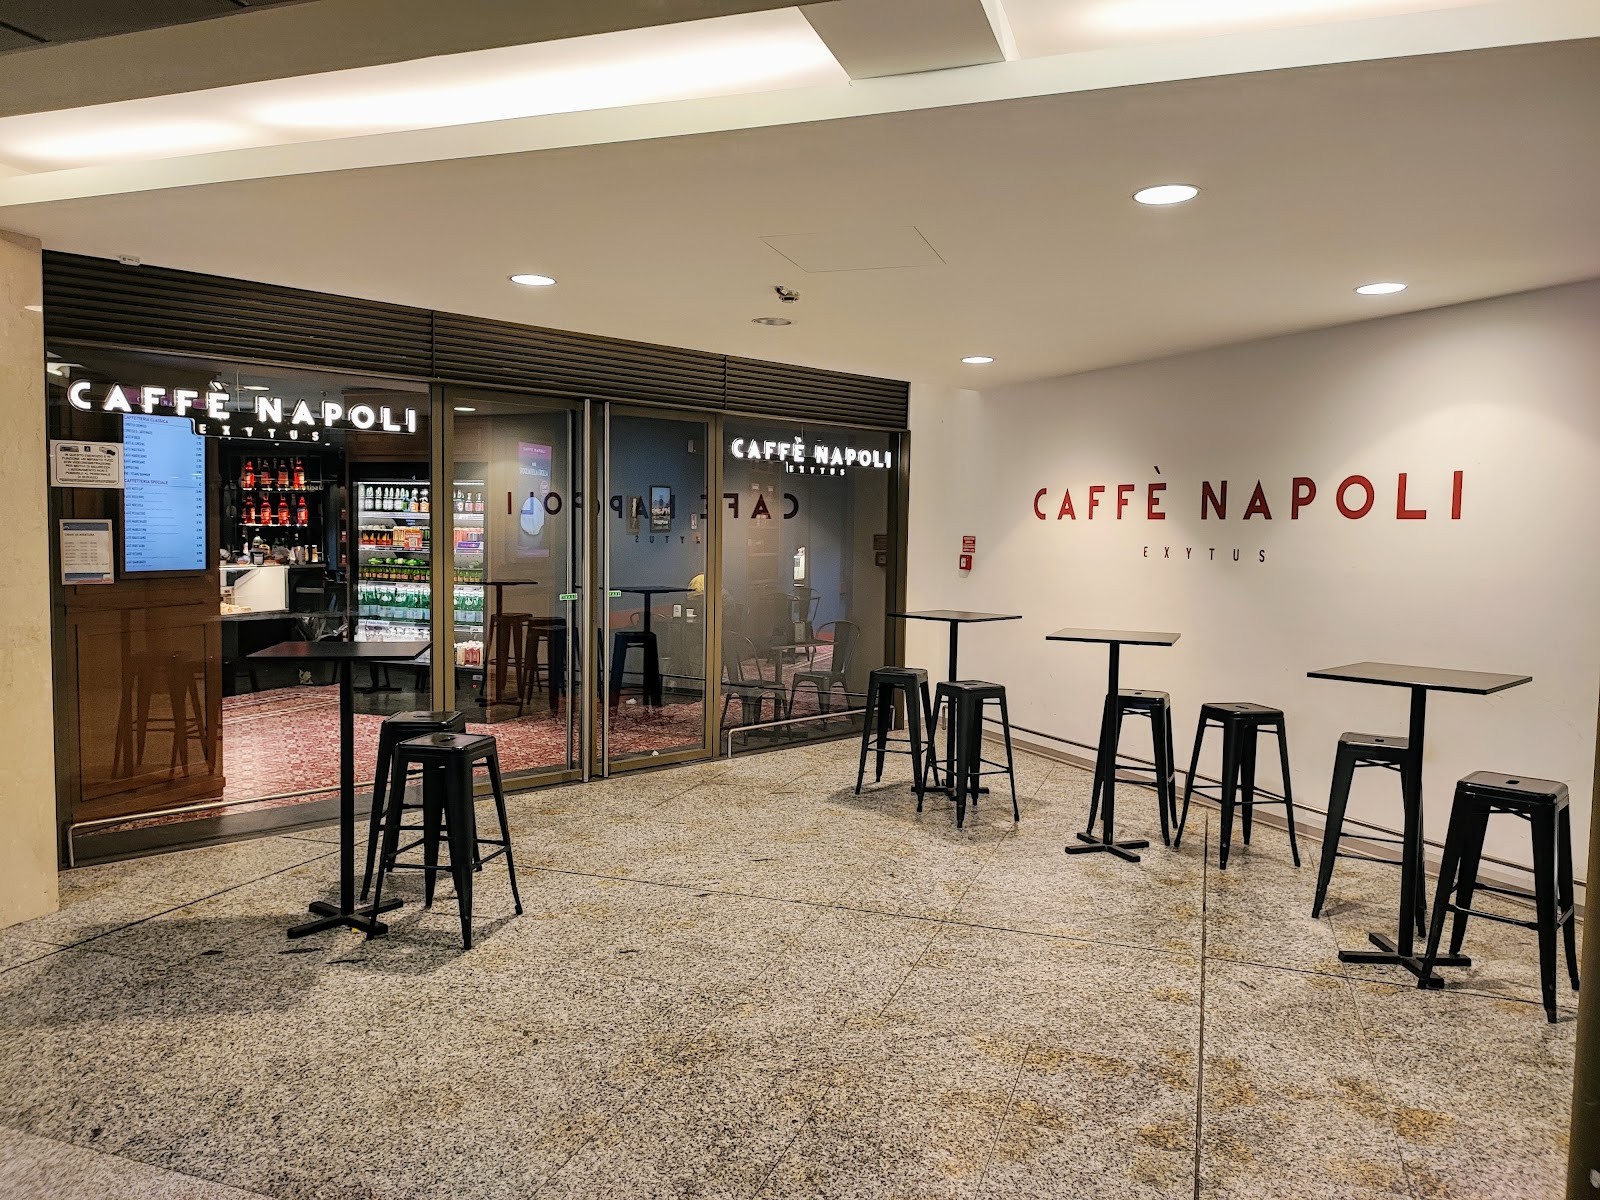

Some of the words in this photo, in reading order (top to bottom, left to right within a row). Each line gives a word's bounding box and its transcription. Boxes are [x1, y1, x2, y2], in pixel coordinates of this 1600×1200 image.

[68, 379, 231, 419] CAFFÈ
[255, 395, 417, 433] NAPOLI
[198, 423, 320, 442] EXYTUS
[731, 435, 805, 463] CAFFÈ
[815, 445, 892, 469] NAPOLI
[788, 464, 846, 476] EXYTUS
[1033, 465, 1167, 520] CAFFÈ
[1200, 470, 1463, 520] NAPOLI
[1143, 546, 1266, 562] EXYTUS
